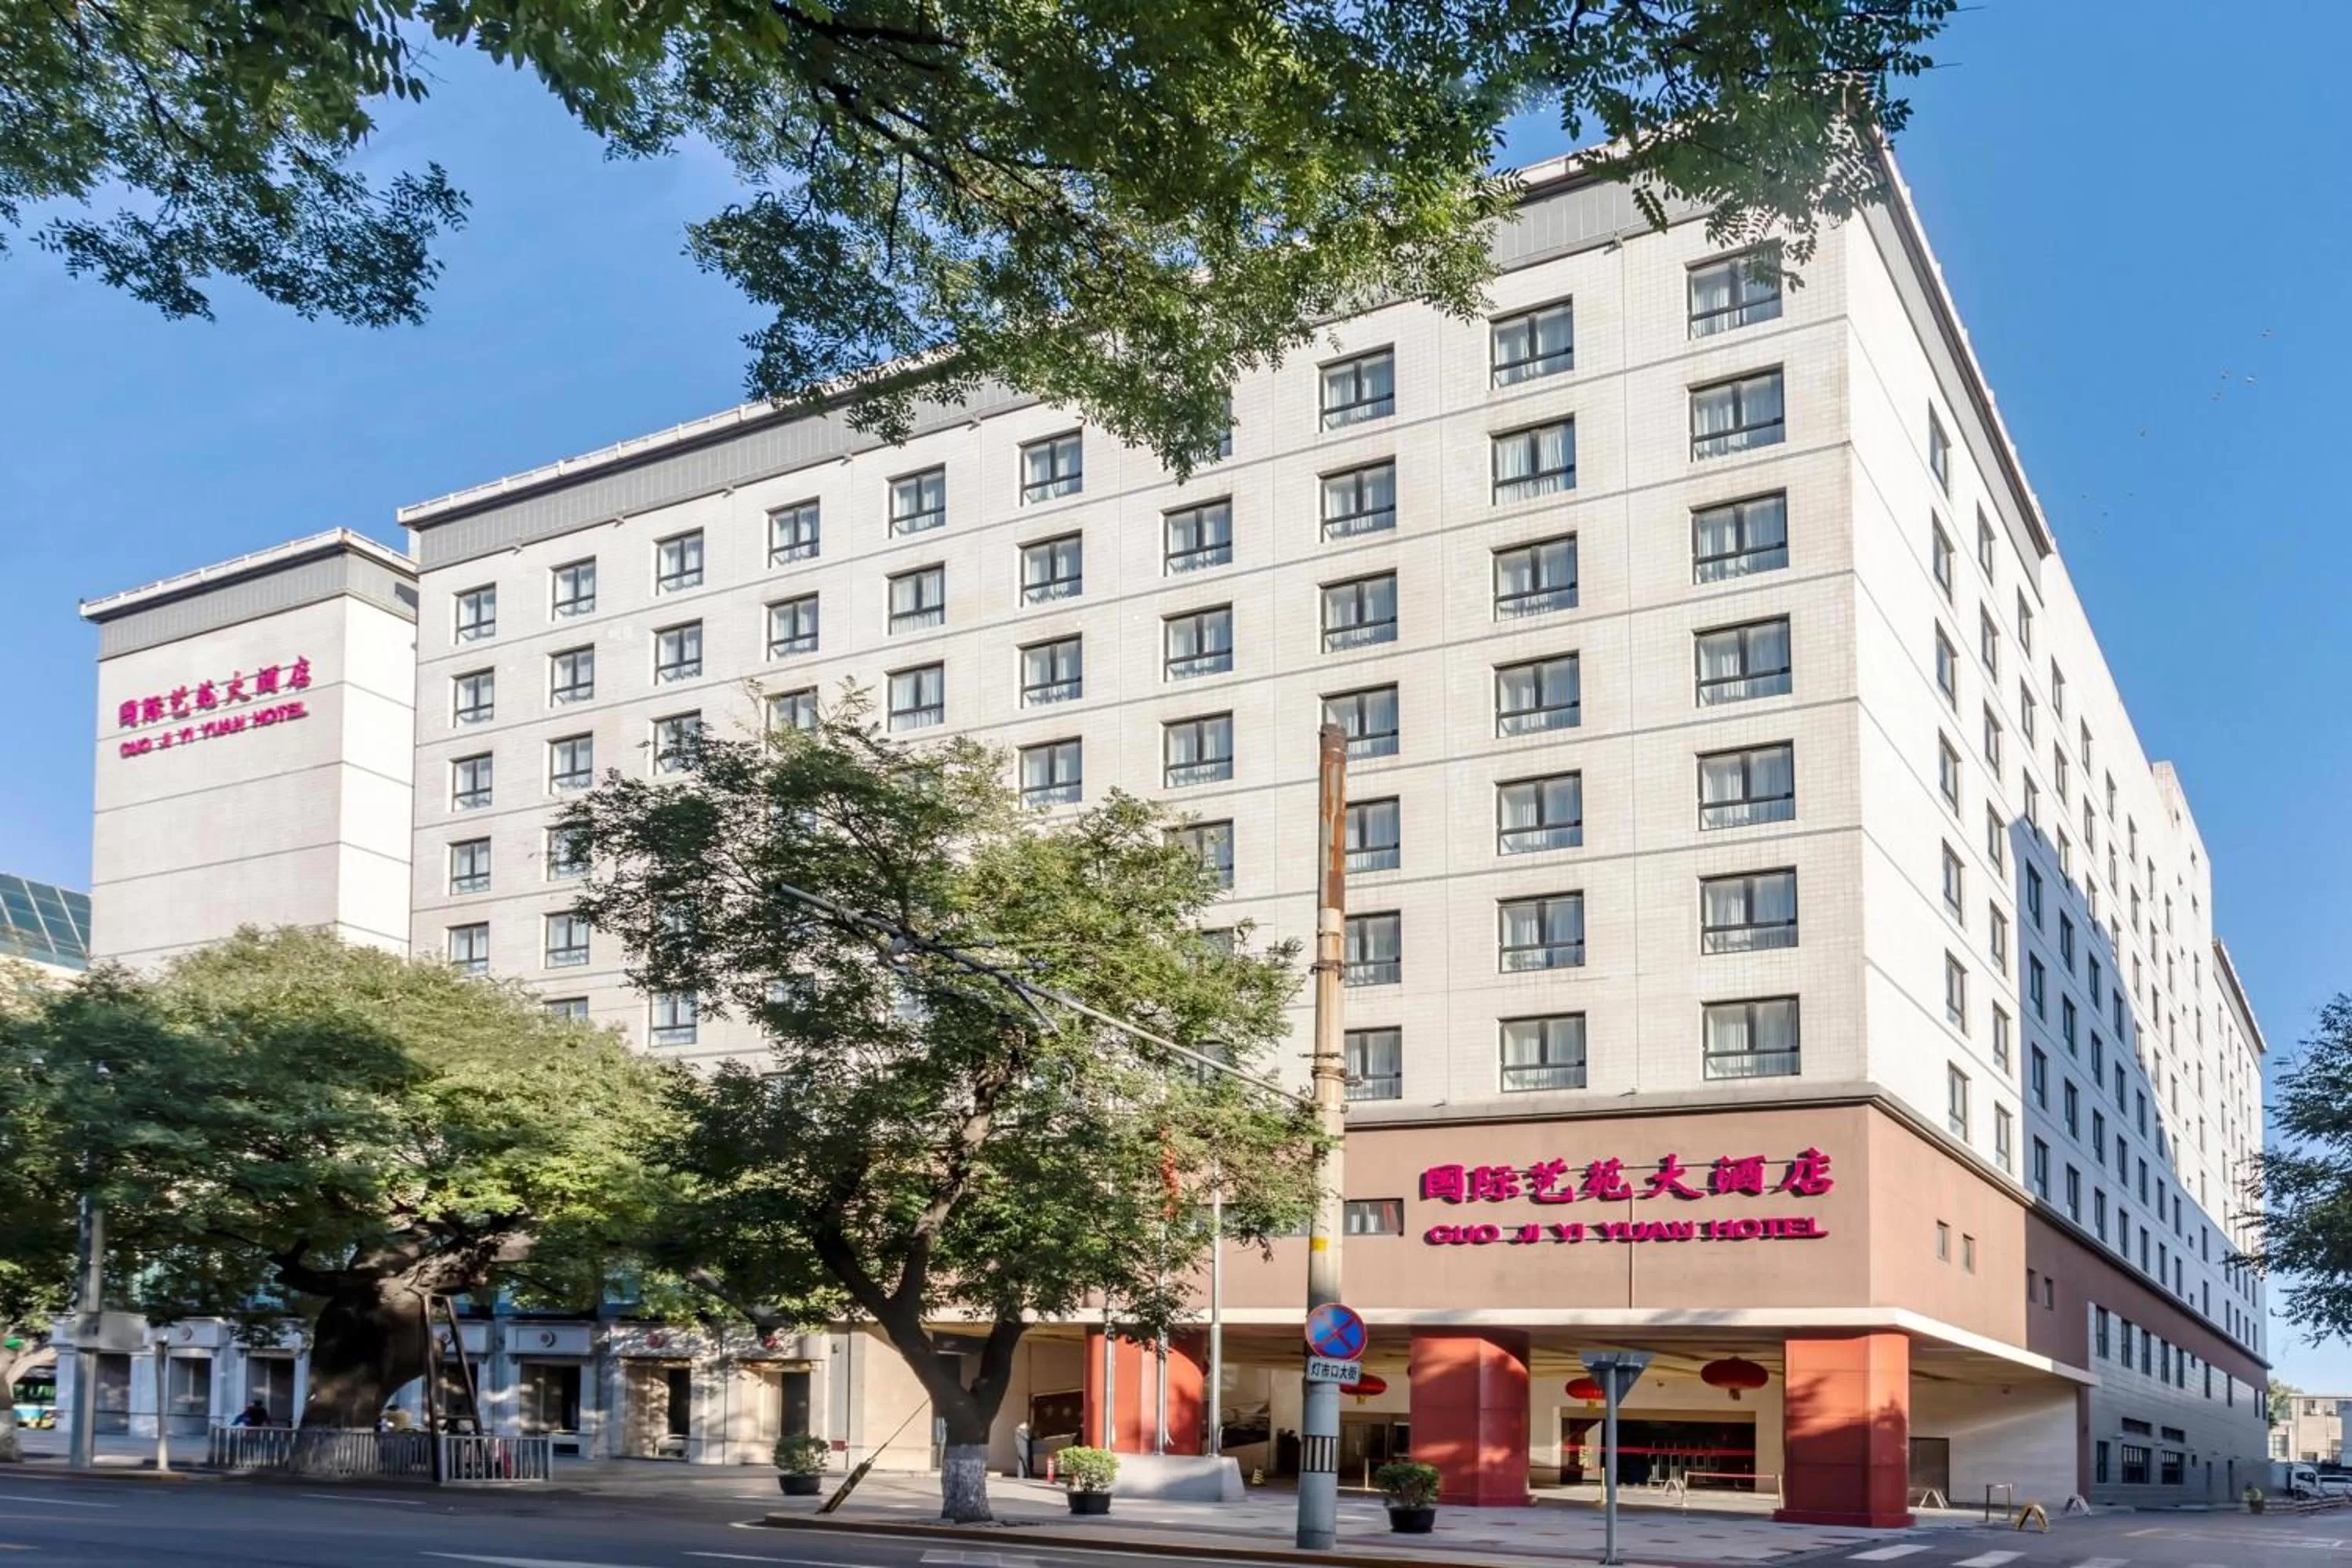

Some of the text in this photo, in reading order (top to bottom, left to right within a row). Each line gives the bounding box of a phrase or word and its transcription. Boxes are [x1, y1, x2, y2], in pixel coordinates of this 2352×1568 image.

[118, 655, 313, 728] 国际艺苑大酒店
[119, 738, 153, 757] GUO
[200, 714, 247, 737] YUAN
[252, 702, 307, 727] HOTEL
[1422, 1148, 1835, 1203] 国际艺苑大酒店
[1428, 1217, 1829, 1243] GUO JI YI YUAN HOTEL
[1310, 1361, 1359, 1380] 灯市口大街
